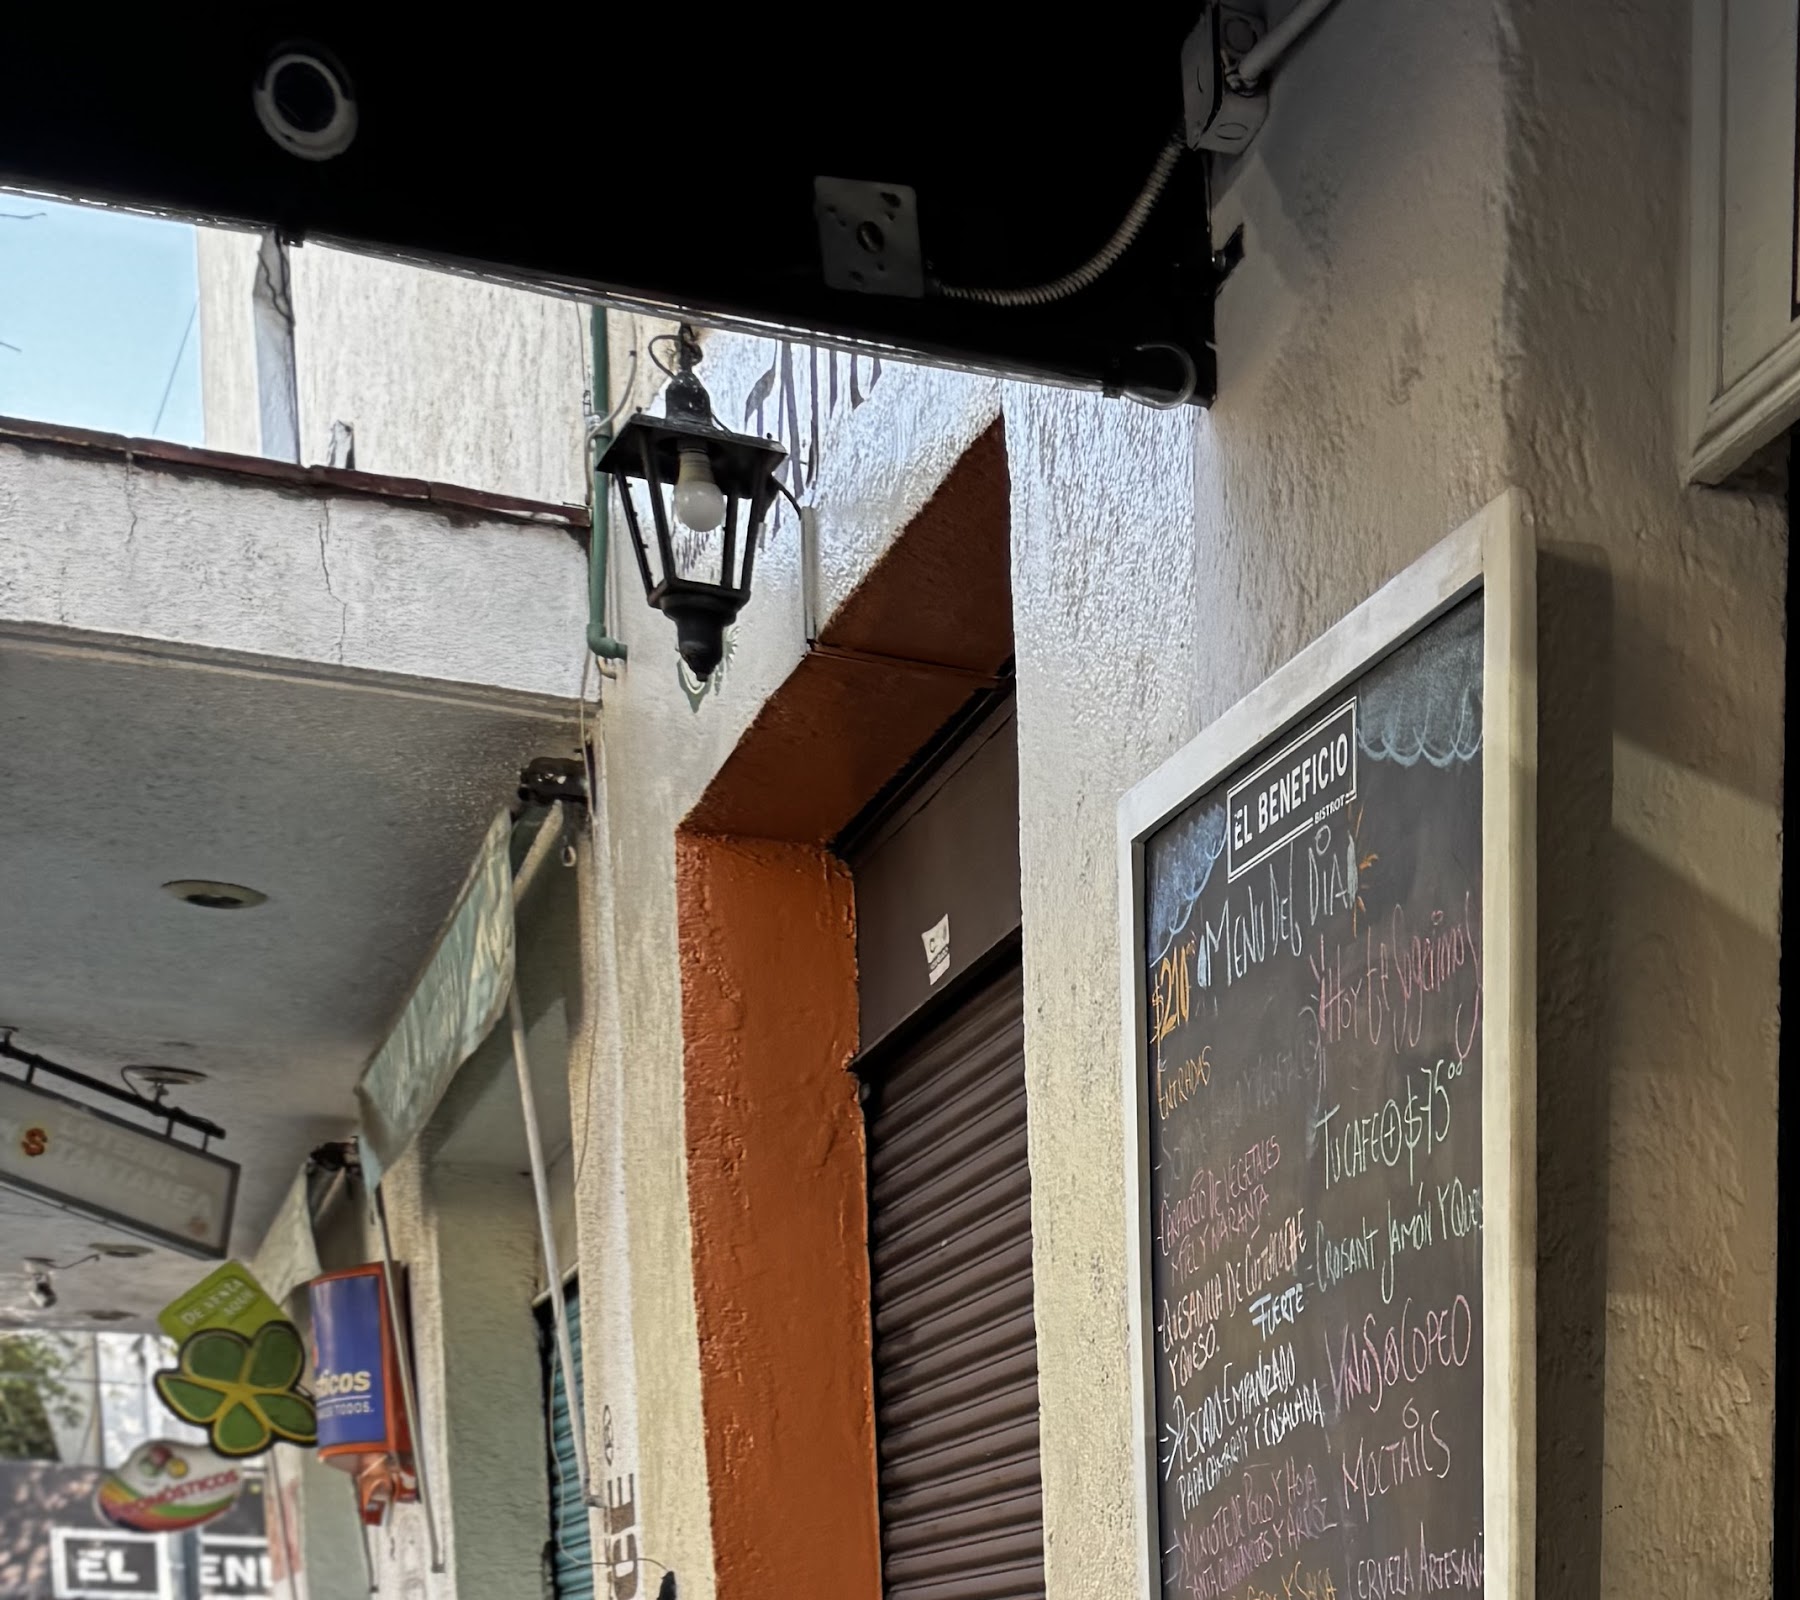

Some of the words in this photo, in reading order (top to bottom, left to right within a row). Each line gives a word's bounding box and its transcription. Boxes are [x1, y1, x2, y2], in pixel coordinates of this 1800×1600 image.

[1234, 804, 1252, 851] EL
[1258, 733, 1348, 834] BENEFICIO
[1314, 795, 1345, 825] BISTROT
[1249, 1283, 1305, 1342] FUERTE
[76, 1549, 139, 1583] EL
